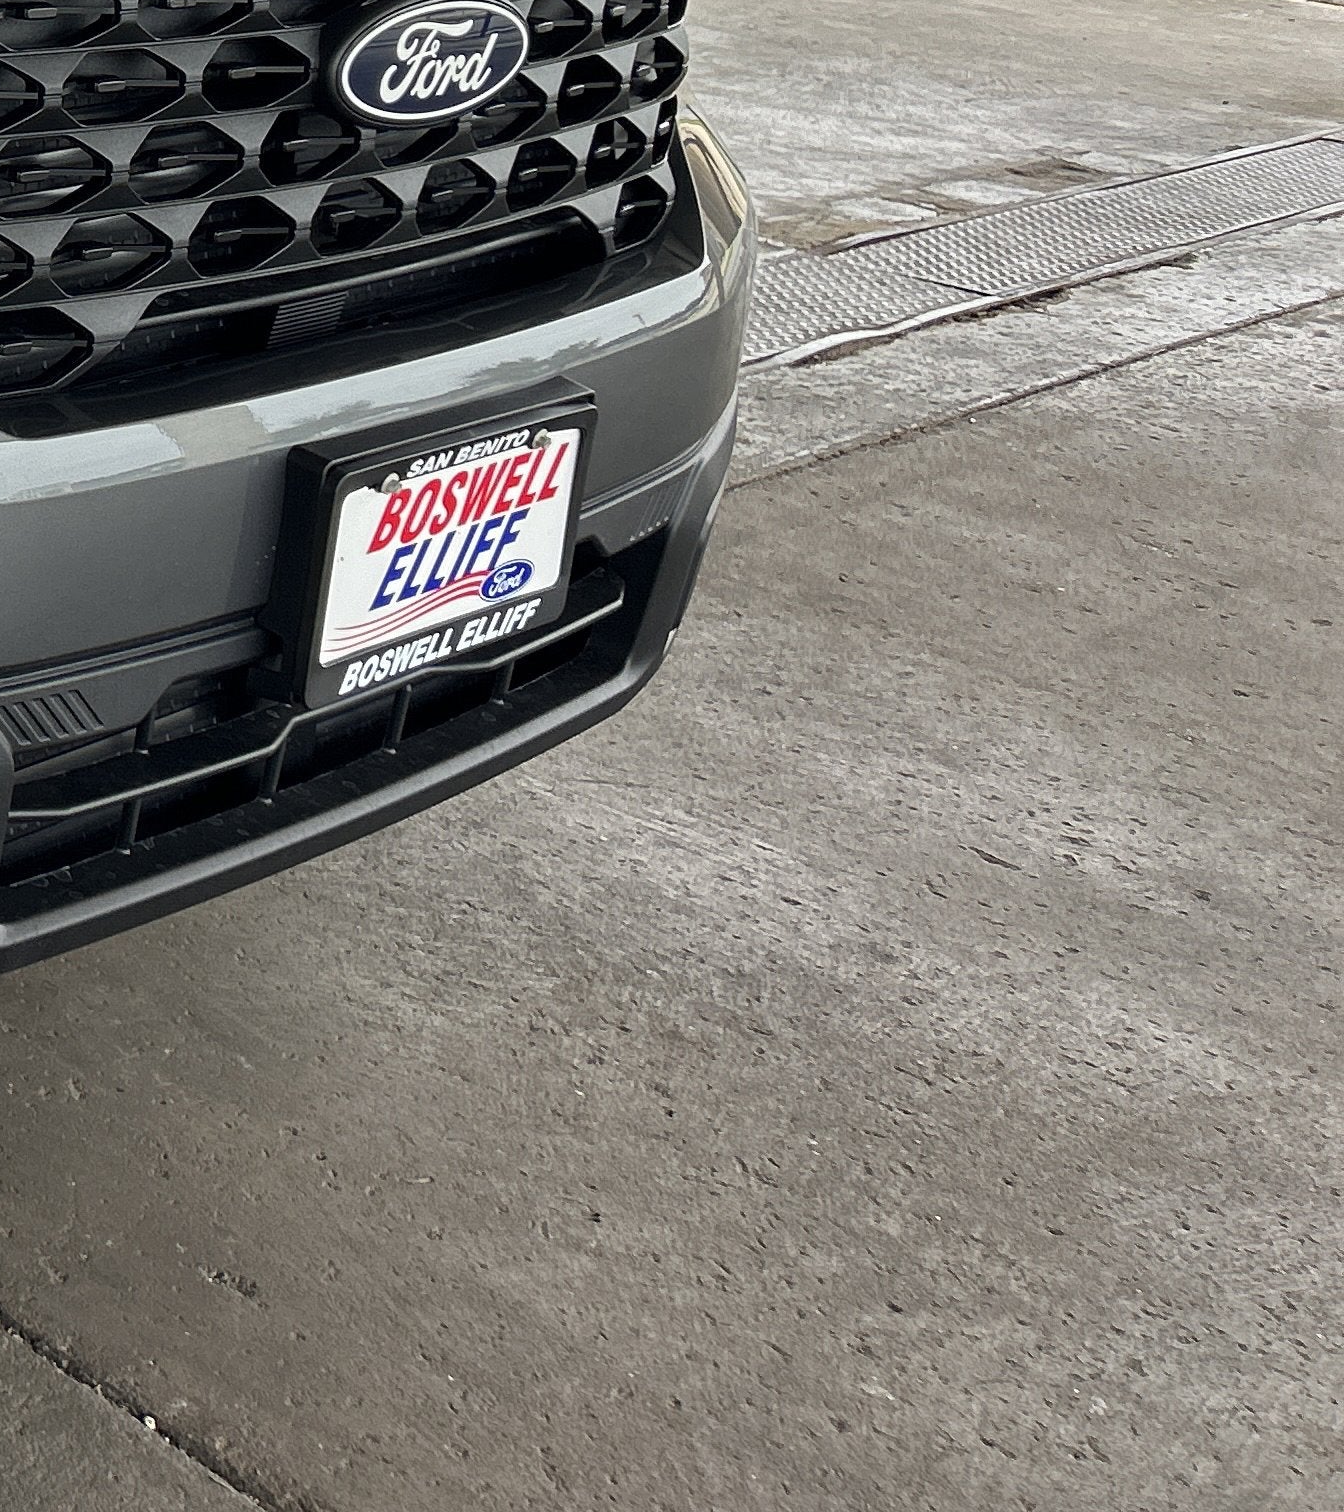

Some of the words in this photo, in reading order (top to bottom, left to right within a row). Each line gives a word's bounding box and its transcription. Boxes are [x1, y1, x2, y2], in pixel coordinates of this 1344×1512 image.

[379, 19, 499, 104] Ford
[366, 441, 570, 555] BOSWELL
[406, 453, 452, 479] SAN
[453, 429, 531, 465] BENITO
[368, 507, 532, 612] ELLIFF
[487, 567, 524, 597] Ford
[337, 626, 455, 696] BOSWELL
[455, 597, 543, 652] ELLIFF
